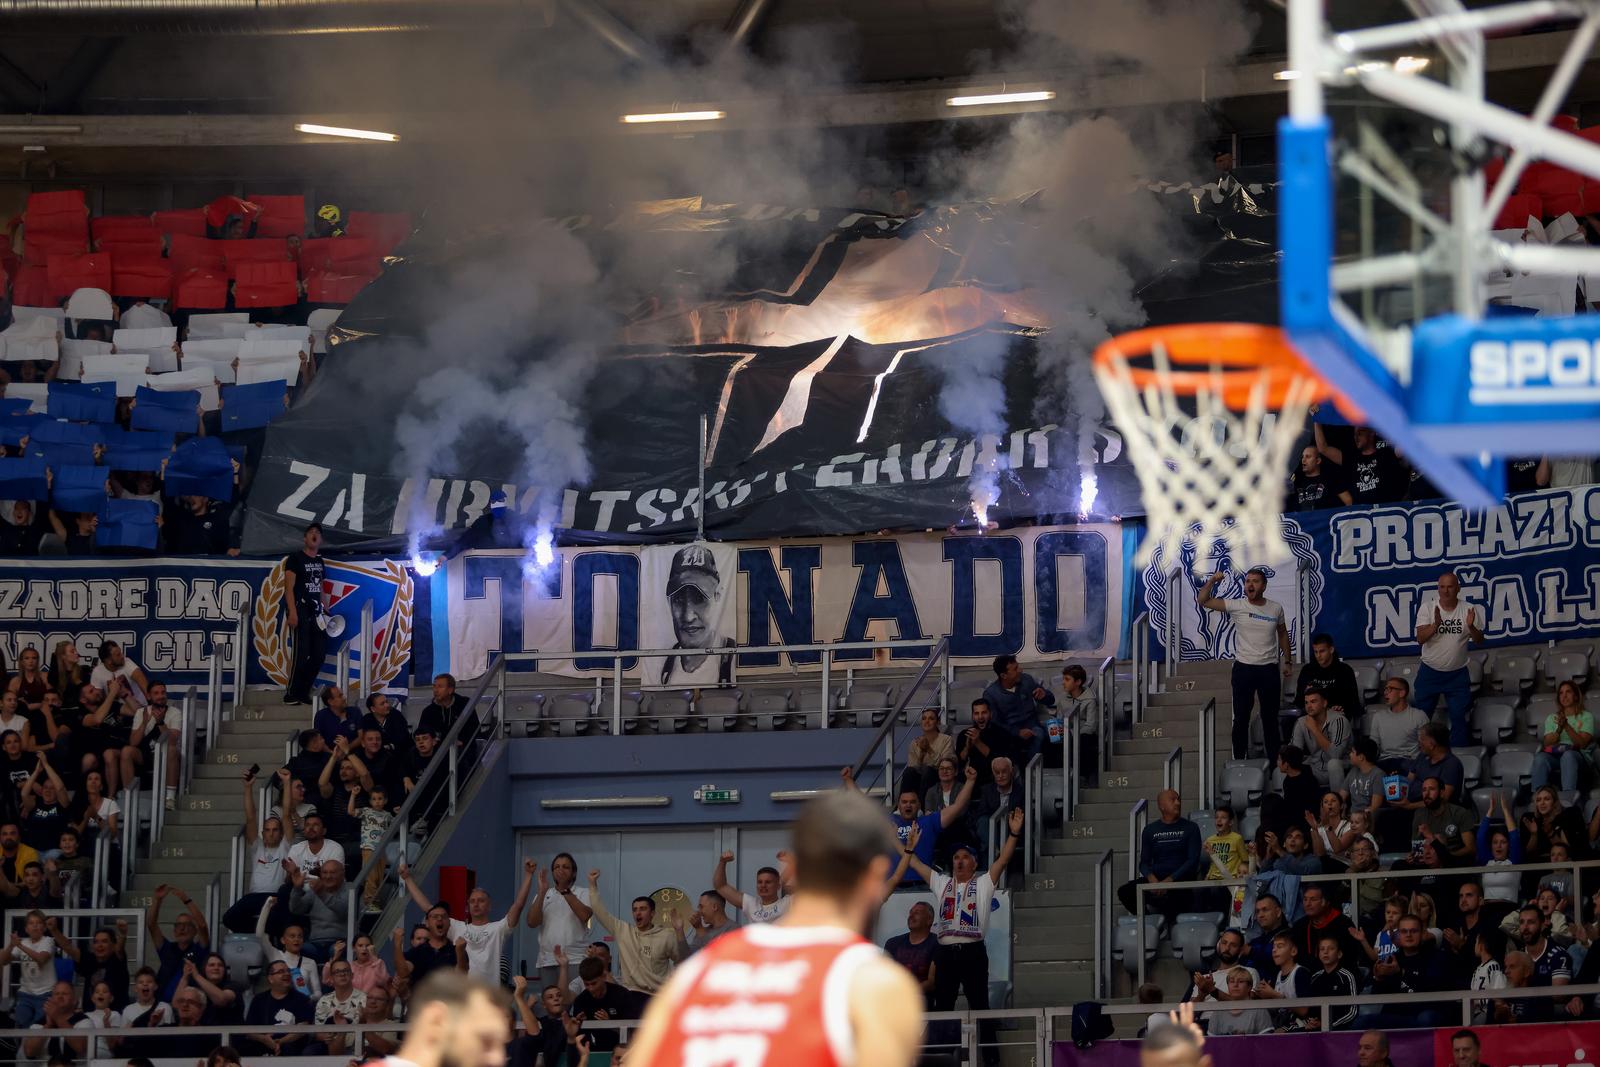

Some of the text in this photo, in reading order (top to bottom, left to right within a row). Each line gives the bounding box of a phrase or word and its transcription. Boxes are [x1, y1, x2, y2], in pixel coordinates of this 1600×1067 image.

[276, 460, 366, 533] ZA
[1333, 490, 1575, 572] PROLAZI
[1368, 566, 1532, 646] NŠA
[661, 889, 670, 902] 8
